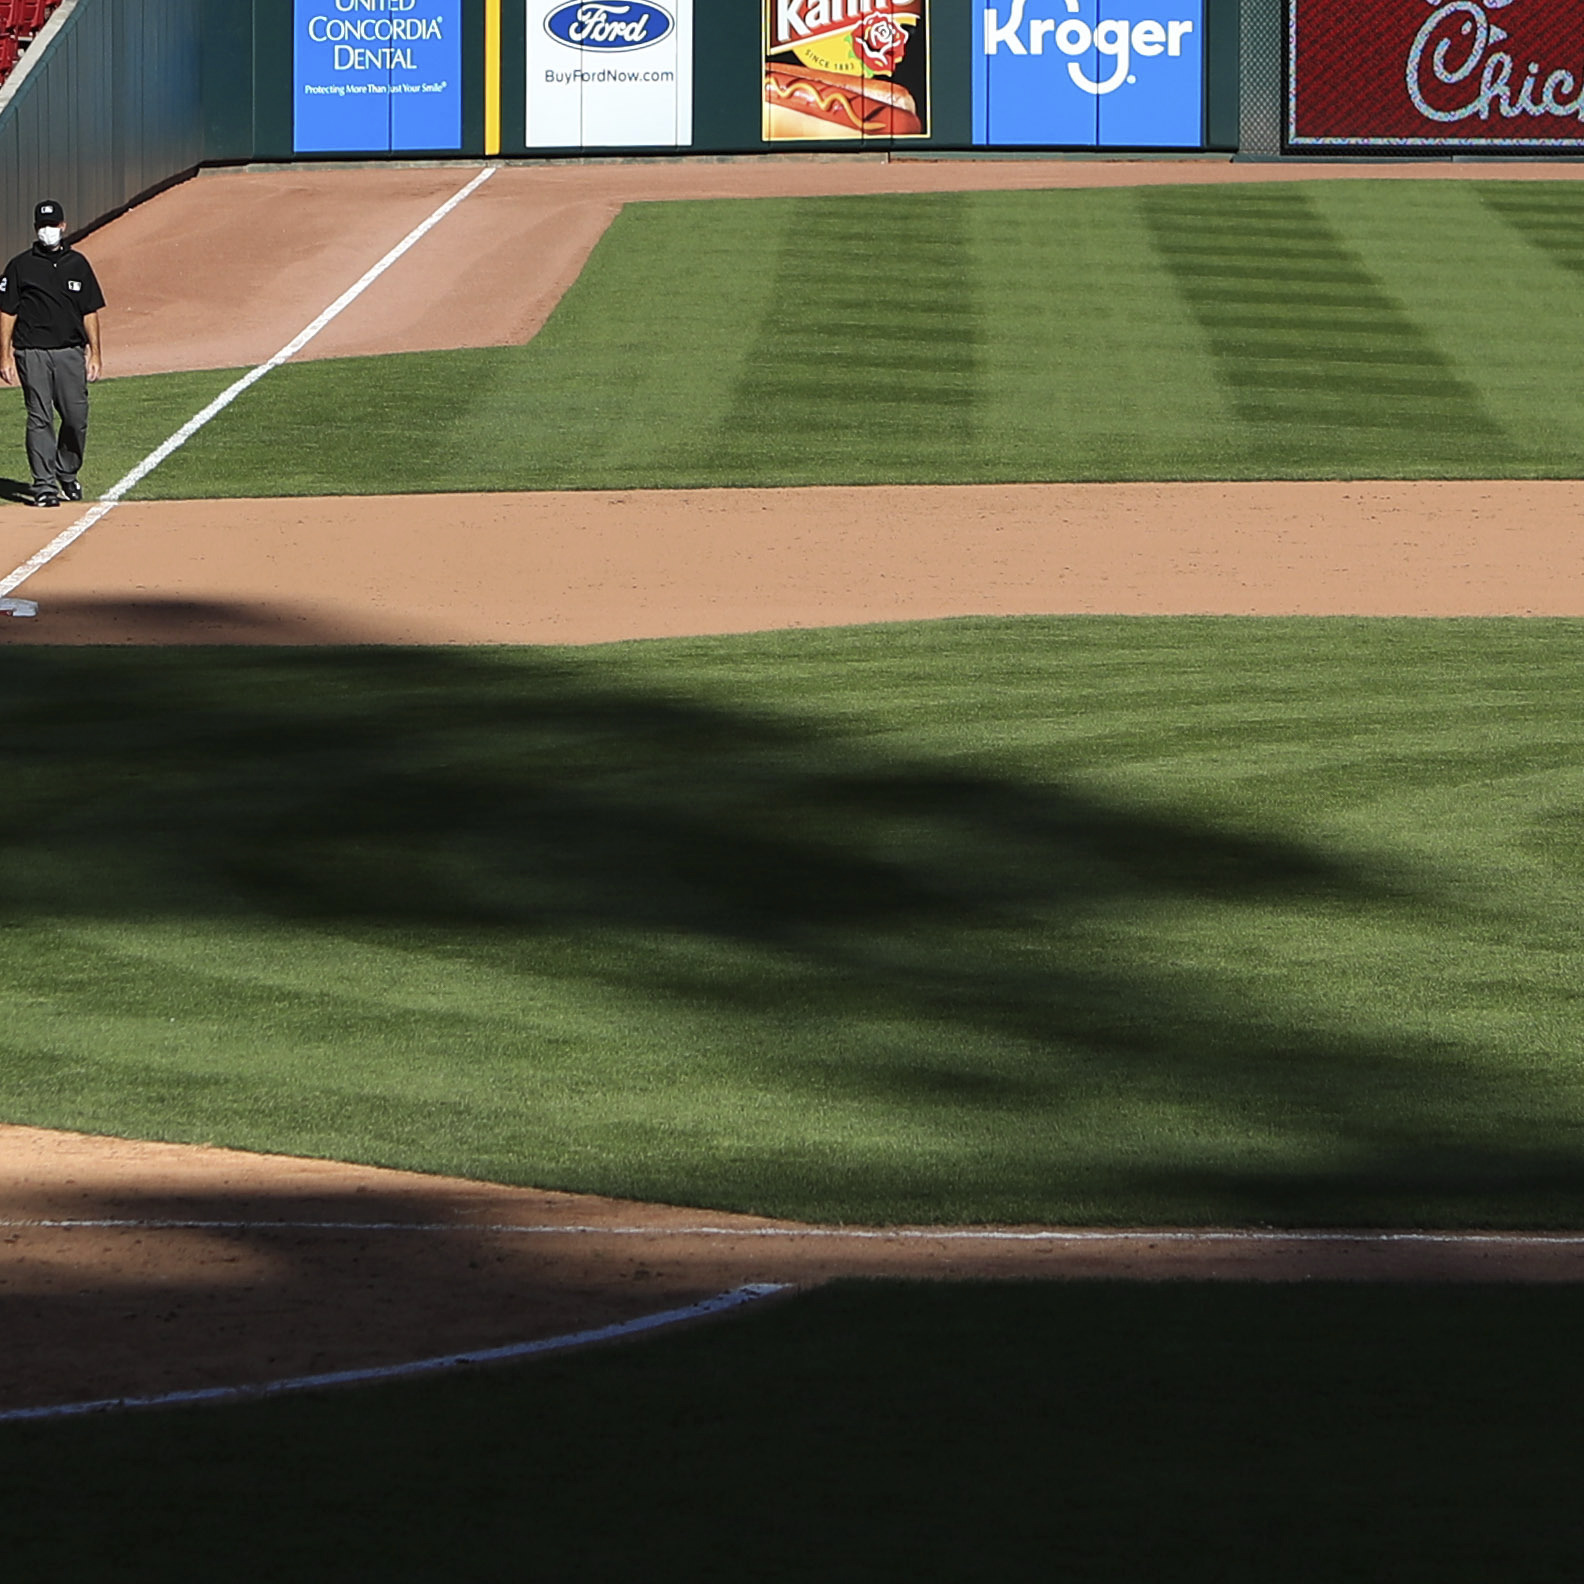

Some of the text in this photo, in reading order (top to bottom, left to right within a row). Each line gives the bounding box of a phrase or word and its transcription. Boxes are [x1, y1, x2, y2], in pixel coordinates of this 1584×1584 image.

[308, 16, 442, 42] CONCORDIA
[568, 3, 649, 44] Ford
[333, 45, 418, 71] DENTAL
[804, 48, 830, 68] SINCE
[304, 84, 346, 97] Protecting
[346, 84, 367, 94] More
[367, 83, 386, 94] Than
[402, 82, 421, 93] Your
[421, 82, 443, 93] Smile
[544, 69, 675, 87] BuyFordNow.com
